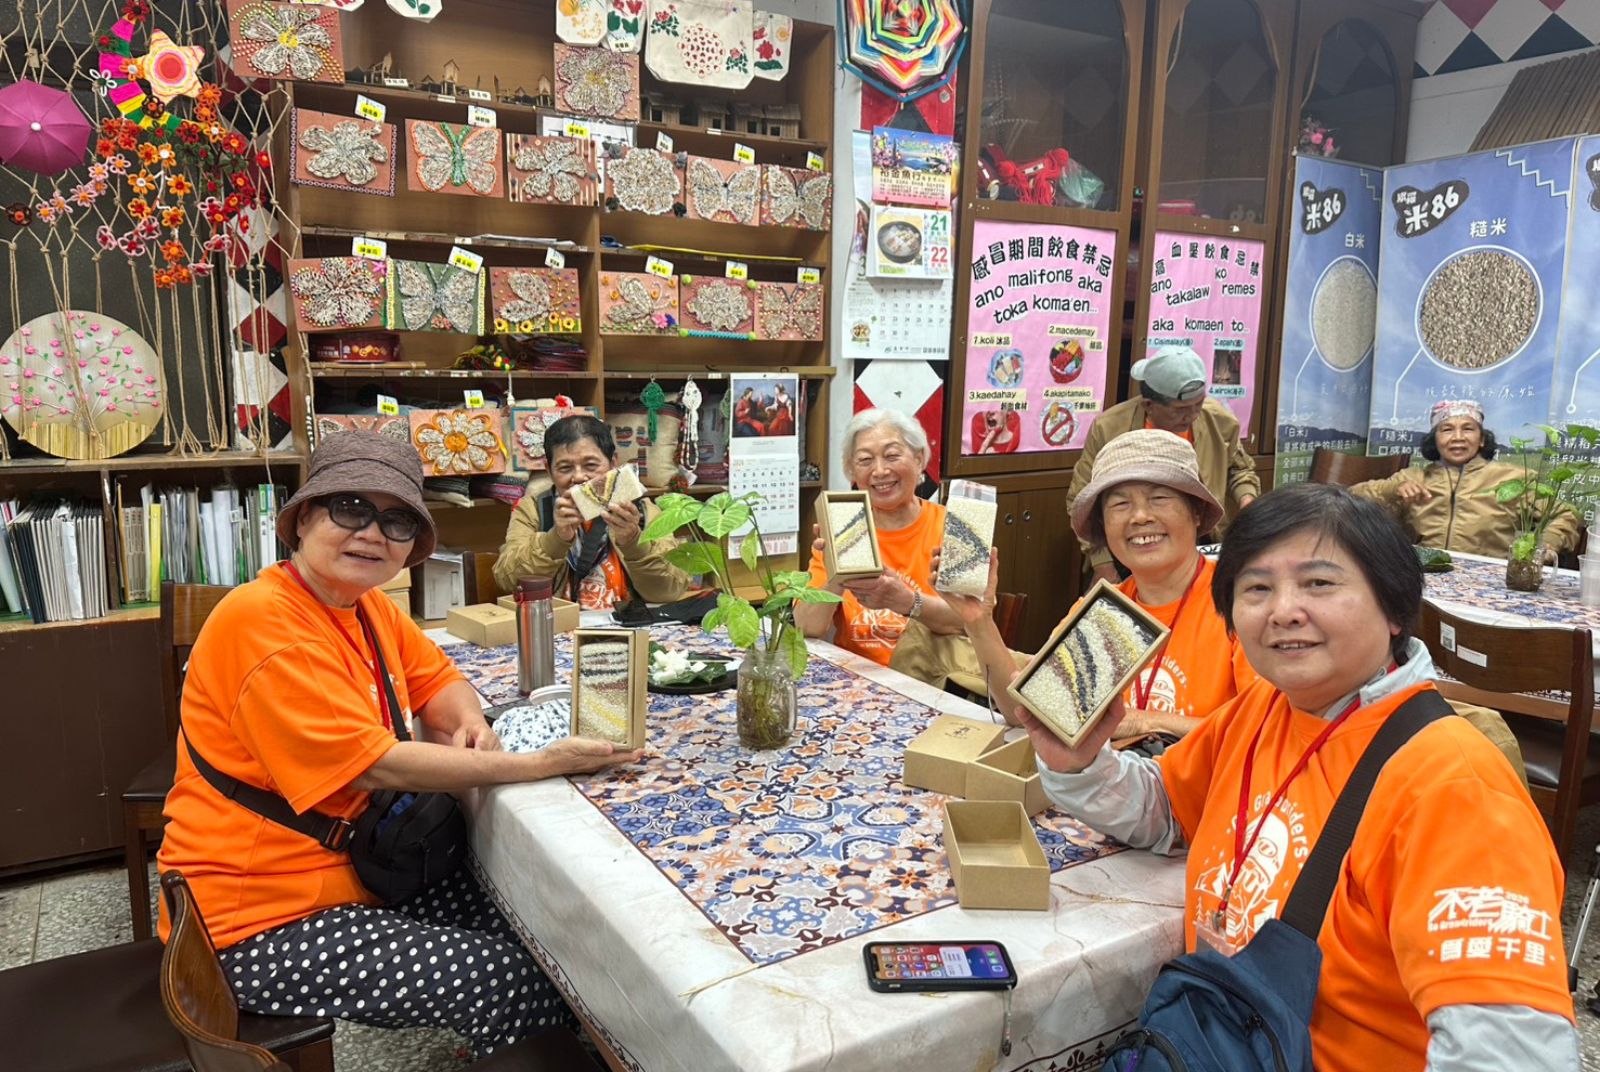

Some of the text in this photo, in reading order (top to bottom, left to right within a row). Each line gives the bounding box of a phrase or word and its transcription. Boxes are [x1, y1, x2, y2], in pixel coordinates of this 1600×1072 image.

[931, 214, 947, 231] 21
[1470, 217, 1507, 238] 糙米
[1345, 232, 1365, 249] 白米
[931, 247, 948, 263] 22
[972, 236, 1112, 280] 感冒期間飲食禁忌
[975, 268, 1102, 308] ano malifong aka
[1151, 267, 1255, 306] ano takalaw ko remes
[993, 300, 1028, 324] toka
[1152, 319, 1174, 331] aka
[1185, 317, 1224, 331] komaen
